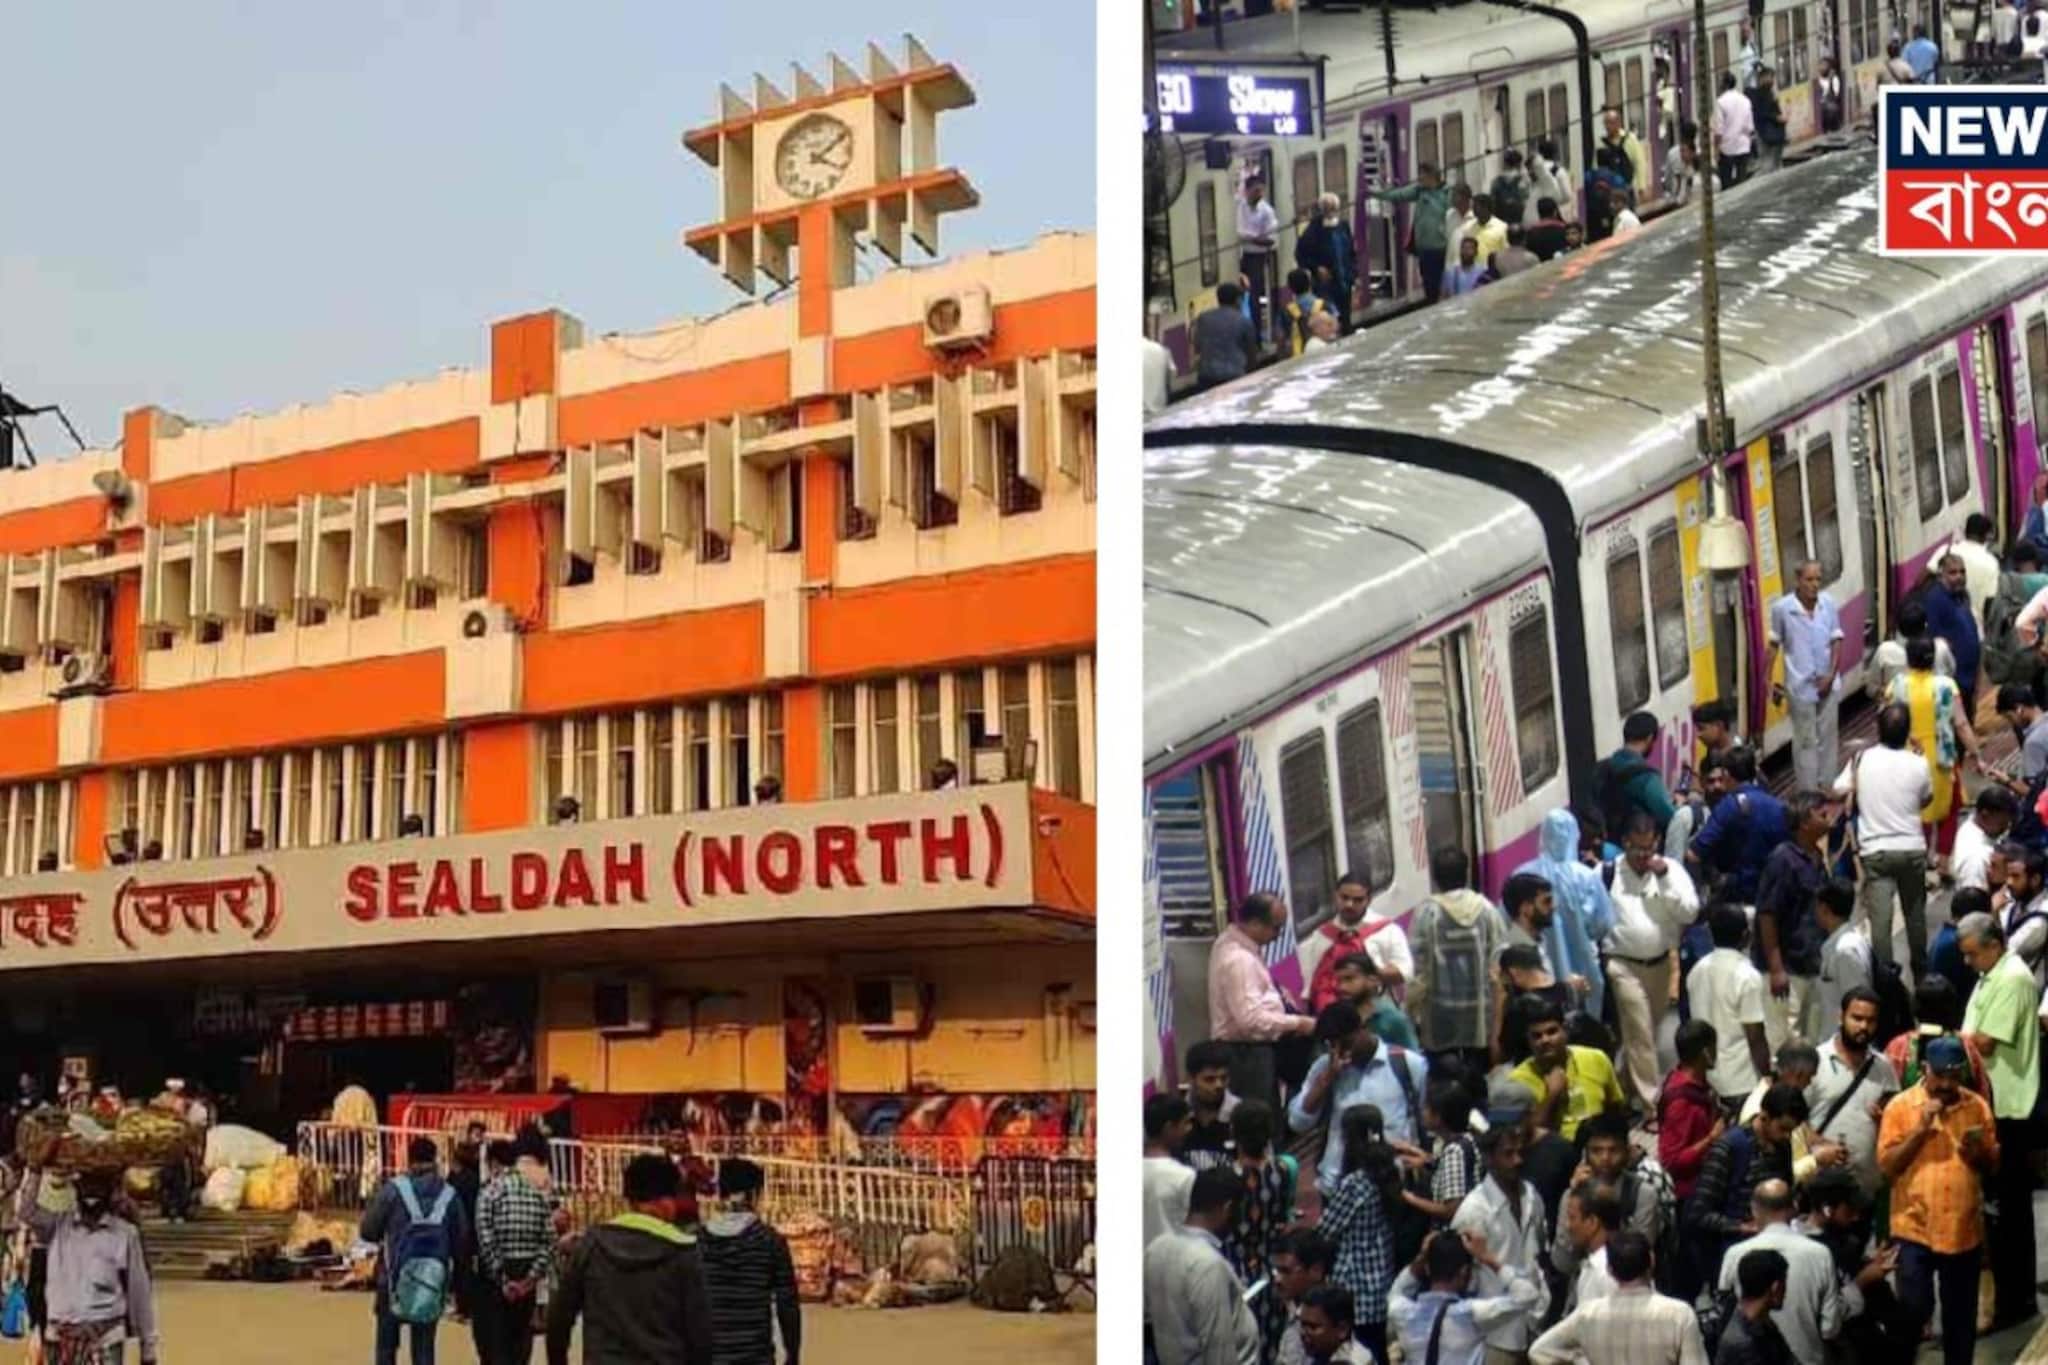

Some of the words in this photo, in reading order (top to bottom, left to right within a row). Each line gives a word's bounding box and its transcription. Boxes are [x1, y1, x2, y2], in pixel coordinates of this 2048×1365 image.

[1227, 73, 1296, 115] Slow
[345, 842, 648, 923] SEALDAH
[673, 803, 1004, 908] (NORTH)
[112, 864, 282, 950] (उत्तर)
